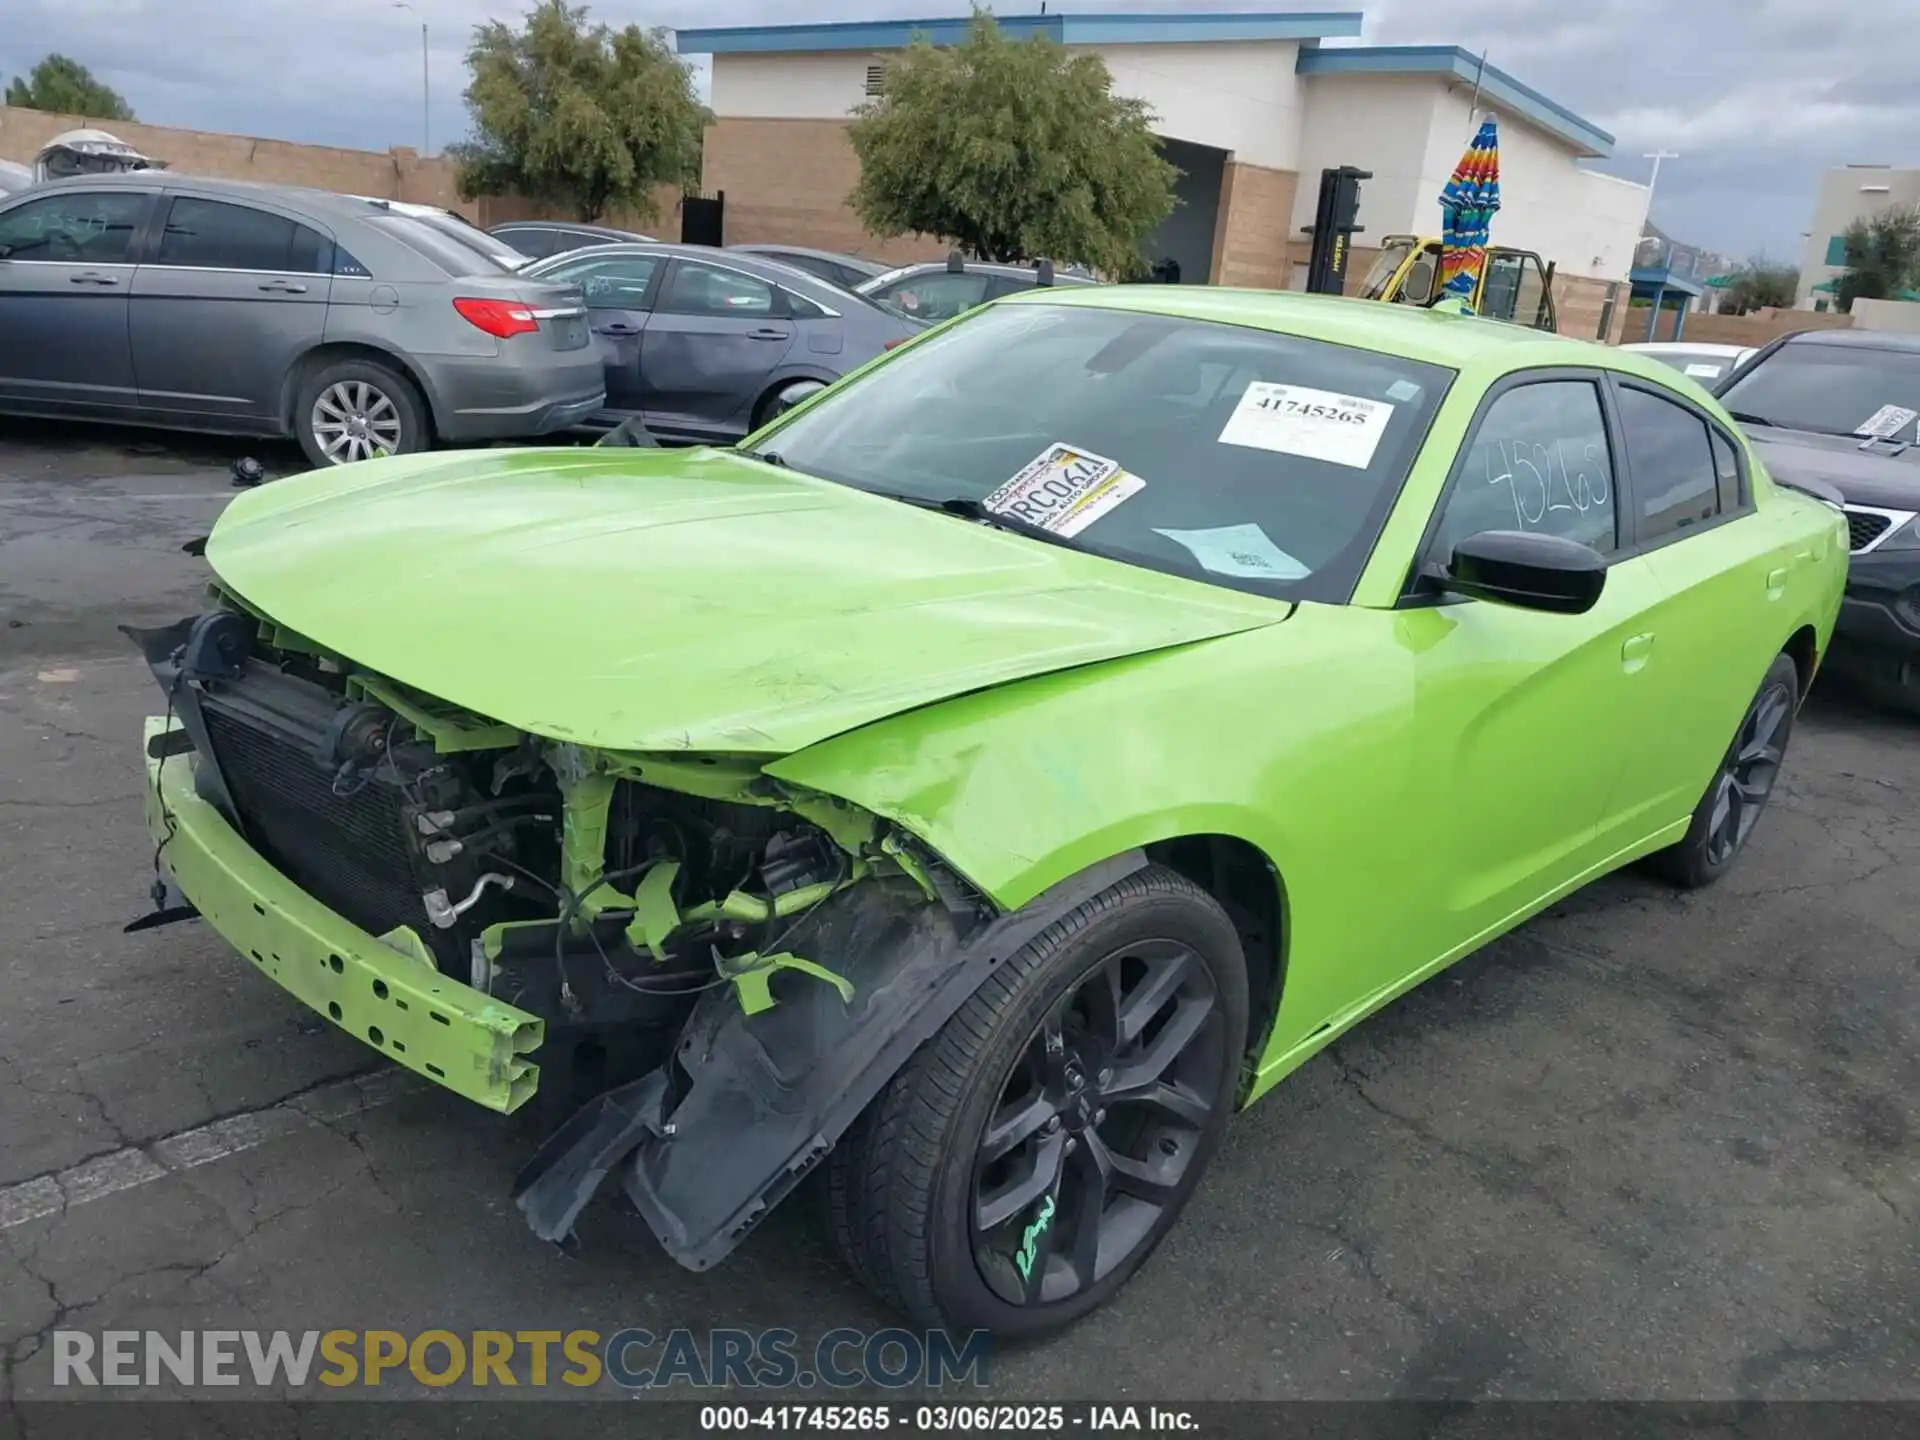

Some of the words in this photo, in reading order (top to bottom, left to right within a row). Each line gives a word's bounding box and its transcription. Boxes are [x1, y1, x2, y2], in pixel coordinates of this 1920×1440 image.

[1331, 235, 1345, 273] HYSTER
[1257, 397, 1368, 425] 41745265
[1059, 489, 1083, 510] AUTO
[1485, 438, 1608, 531] 45265
